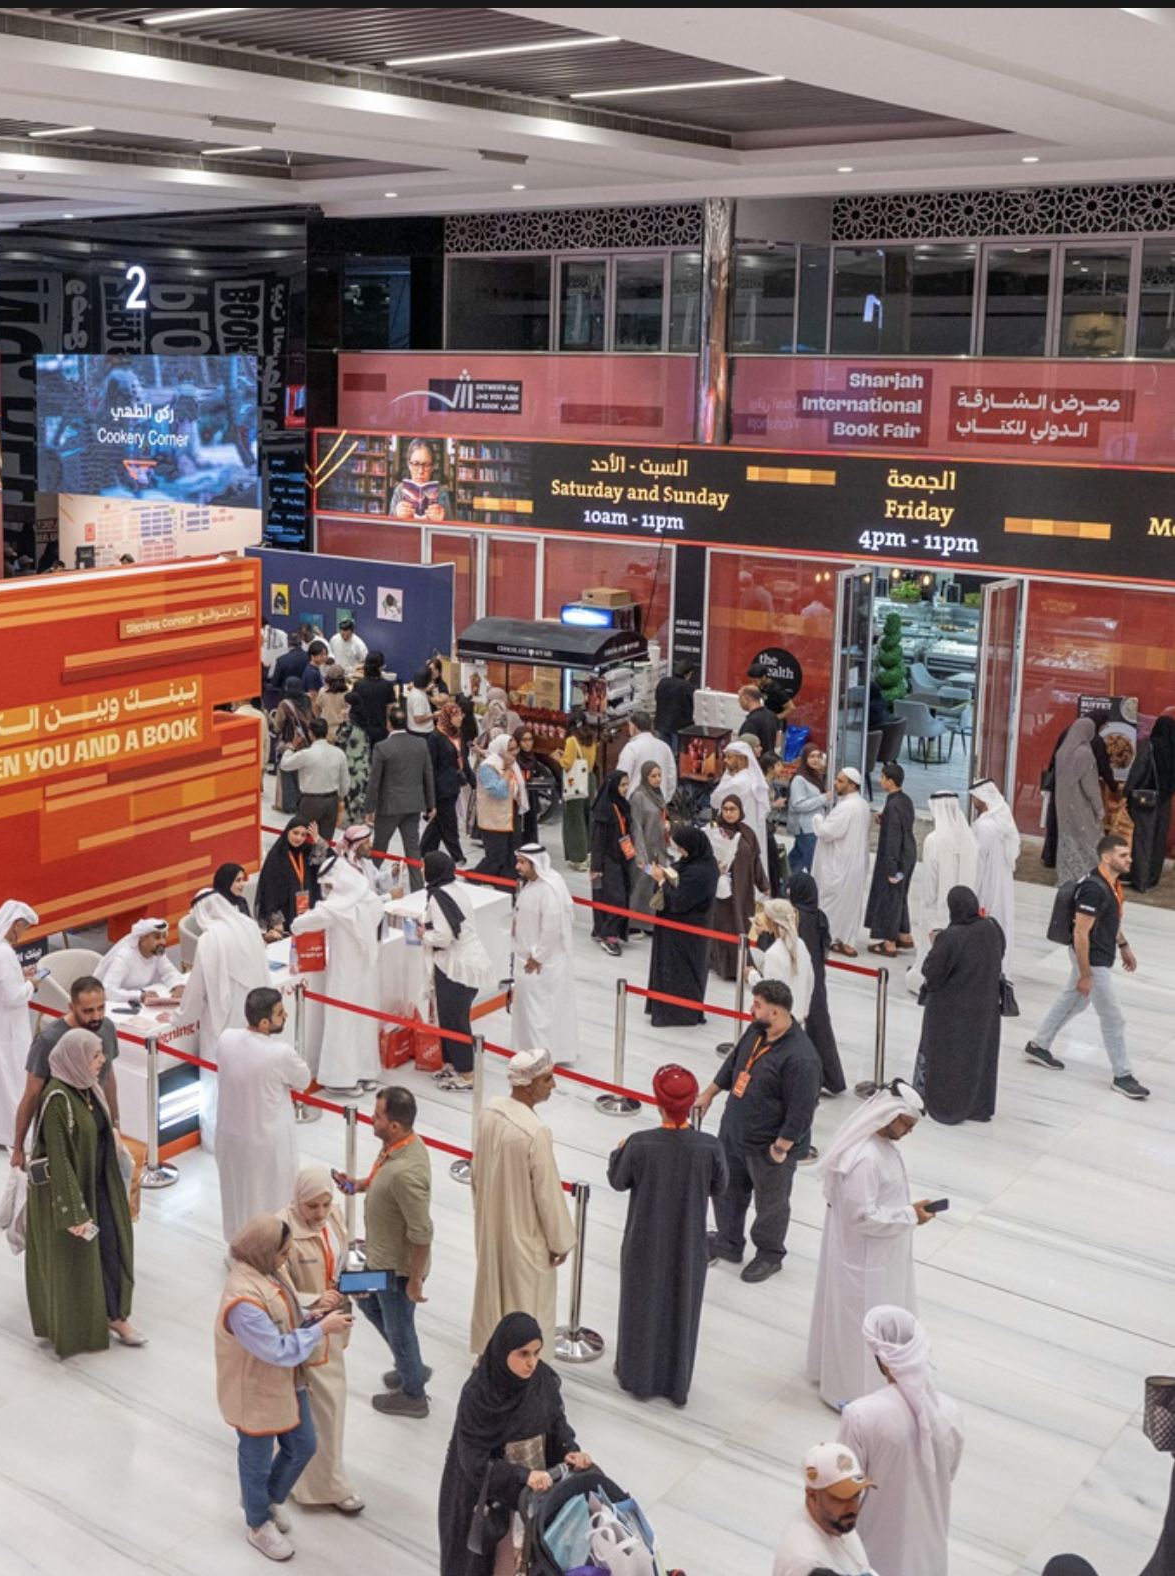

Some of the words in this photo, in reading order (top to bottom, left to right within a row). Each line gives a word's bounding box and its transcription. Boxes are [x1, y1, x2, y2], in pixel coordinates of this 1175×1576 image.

[125, 265, 147, 310] 2
[849, 372, 924, 390] Sharjah
[802, 396, 922, 414] International
[957, 388, 1047, 413] الشارقة
[1050, 394, 1121, 416] معرض
[110, 403, 152, 421] الطهي
[154, 404, 174, 424] ركن
[97, 427, 145, 448] Cookery
[148, 430, 189, 447] Corner
[833, 421, 879, 437] Book
[883, 422, 921, 438] Fair
[955, 418, 1027, 437] للكتاب
[1030, 420, 1088, 444] الدولي
[590, 452, 625, 474] الأحد
[639, 459, 688, 479] السبت
[887, 468, 956, 495] الجمعة
[551, 479, 624, 504] Saturday
[627, 485, 659, 502] and
[663, 486, 730, 511] Sunday
[583, 510, 628, 526] 10am
[641, 514, 684, 532] 11pm
[884, 499, 955, 528] Friday
[1147, 516, 1175, 537] M
[858, 529, 907, 550] 4pm
[924, 533, 979, 556] 11pm
[299, 578, 366, 606] CANVAS
[126, 620, 161, 634] Signing
[162, 615, 195, 628] Corner
[759, 654, 778, 666] the
[767, 666, 794, 679] ealth
[124, 681, 198, 711] بينك
[44, 696, 119, 732] وبين
[24, 743, 70, 773] YOU
[74, 733, 120, 763] AND
[125, 729, 140, 751] A
[142, 716, 198, 742] BOOK
[157, 1023, 196, 1044] igning
